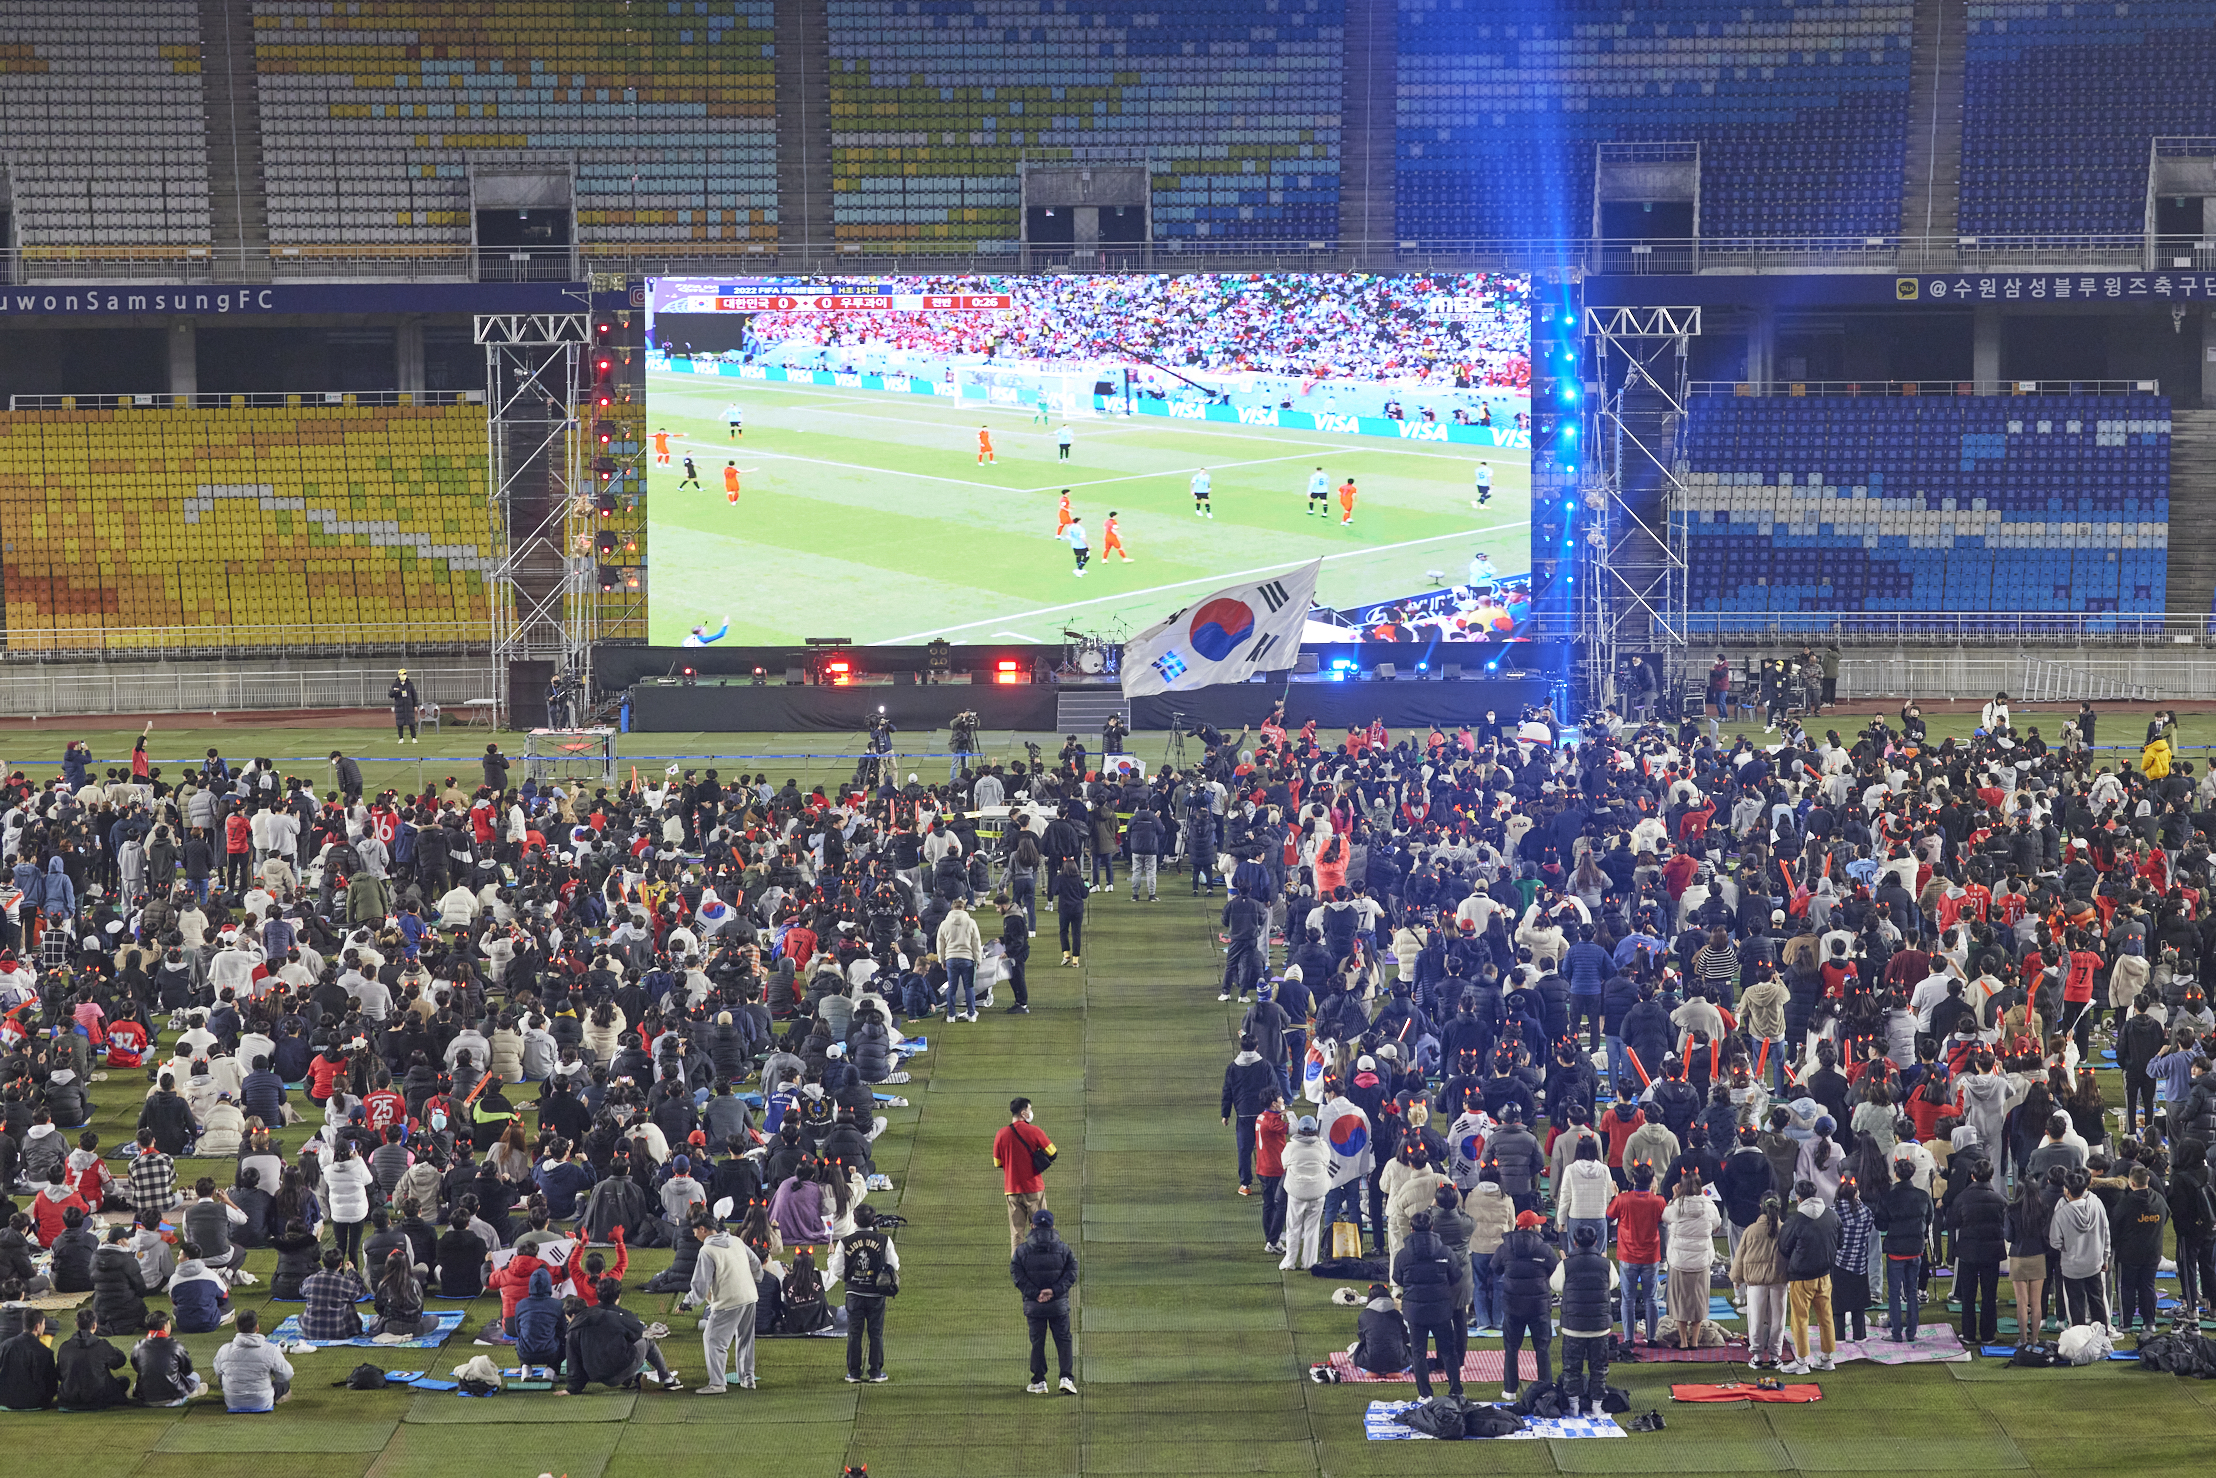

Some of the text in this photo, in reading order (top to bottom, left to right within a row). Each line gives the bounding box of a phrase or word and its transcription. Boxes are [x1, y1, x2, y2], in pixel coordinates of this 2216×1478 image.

[733, 286, 757, 295] 2022
[758, 286, 780, 295] FIFA
[723, 297, 998, 309] 대한민국 0 0 우루과이 전반 0:26
[1430, 297, 1495, 312] MBC
[691, 360, 720, 375] VISA
[738, 364, 766, 379] VISA
[785, 368, 813, 384] VISA
[833, 372, 862, 388] VISA
[882, 376, 911, 393] VISA
[1165, 400, 1207, 420] VISA
[1235, 406, 1280, 427] VISA
[1312, 413, 1360, 434] VISA
[1394, 419, 1448, 442] VISA
[1488, 427, 1532, 449] VIS
[371, 815, 392, 841] 16
[1512, 821, 1528, 829] FILA
[230, 827, 238, 842] 7
[1859, 869, 1874, 885] 10
[1358, 911, 1369, 928] 7
[2009, 907, 2022, 924] 16
[793, 940, 804, 957] 7
[2077, 967, 2089, 985] 7
[115, 1032, 135, 1049] 97
[372, 1099, 394, 1121] 25
[2137, 1213, 2160, 1224] Jeep
[846, 1238, 864, 1256] AJOU
